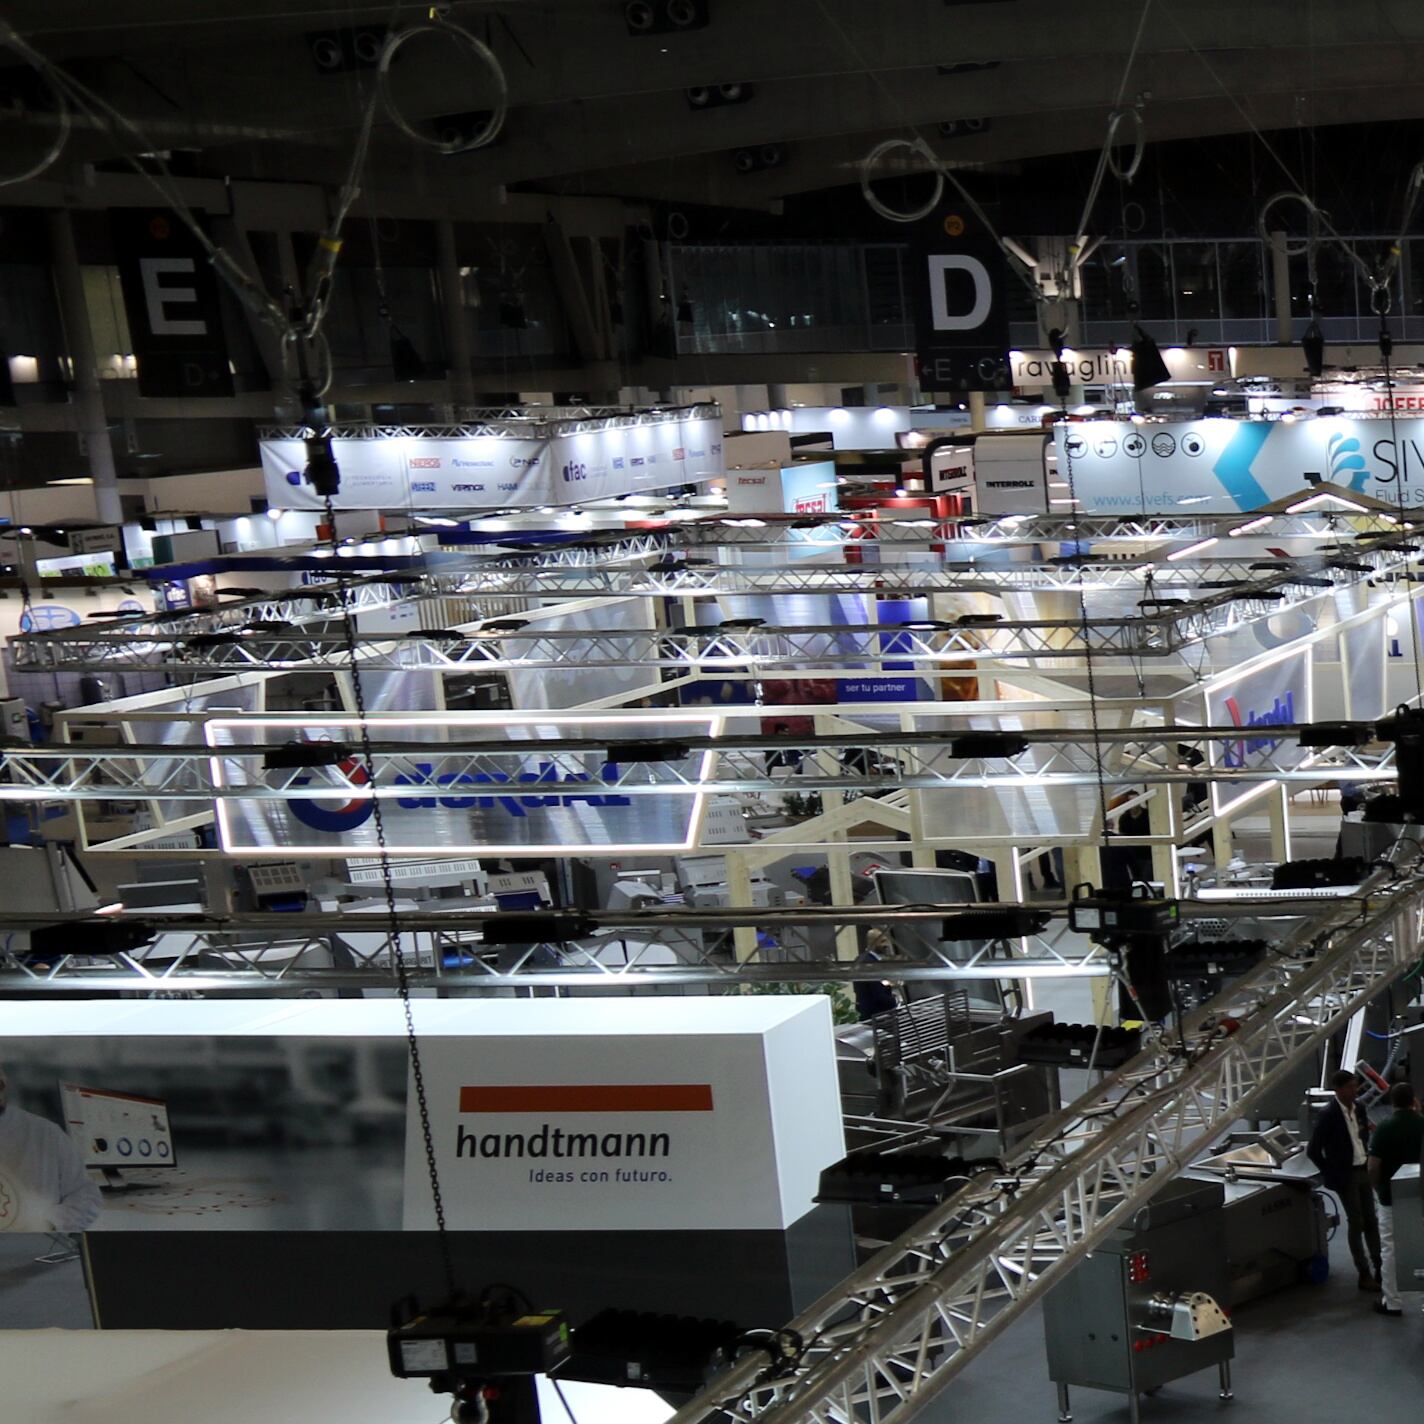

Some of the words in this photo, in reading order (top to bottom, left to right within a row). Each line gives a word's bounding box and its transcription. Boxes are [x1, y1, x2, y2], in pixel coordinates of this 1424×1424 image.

[140, 258, 206, 334] E
[927, 254, 992, 331] D
[985, 480, 1035, 489] INTERROLL
[1375, 487, 1410, 504] Fluid
[845, 684, 859, 692] ser
[862, 683, 870, 692] tu
[873, 683, 906, 694] partner
[456, 1124, 671, 1159] handtmann
[528, 1169, 574, 1183] Ideas
[580, 1170, 609, 1183] con
[615, 1168, 673, 1183] futuro.
